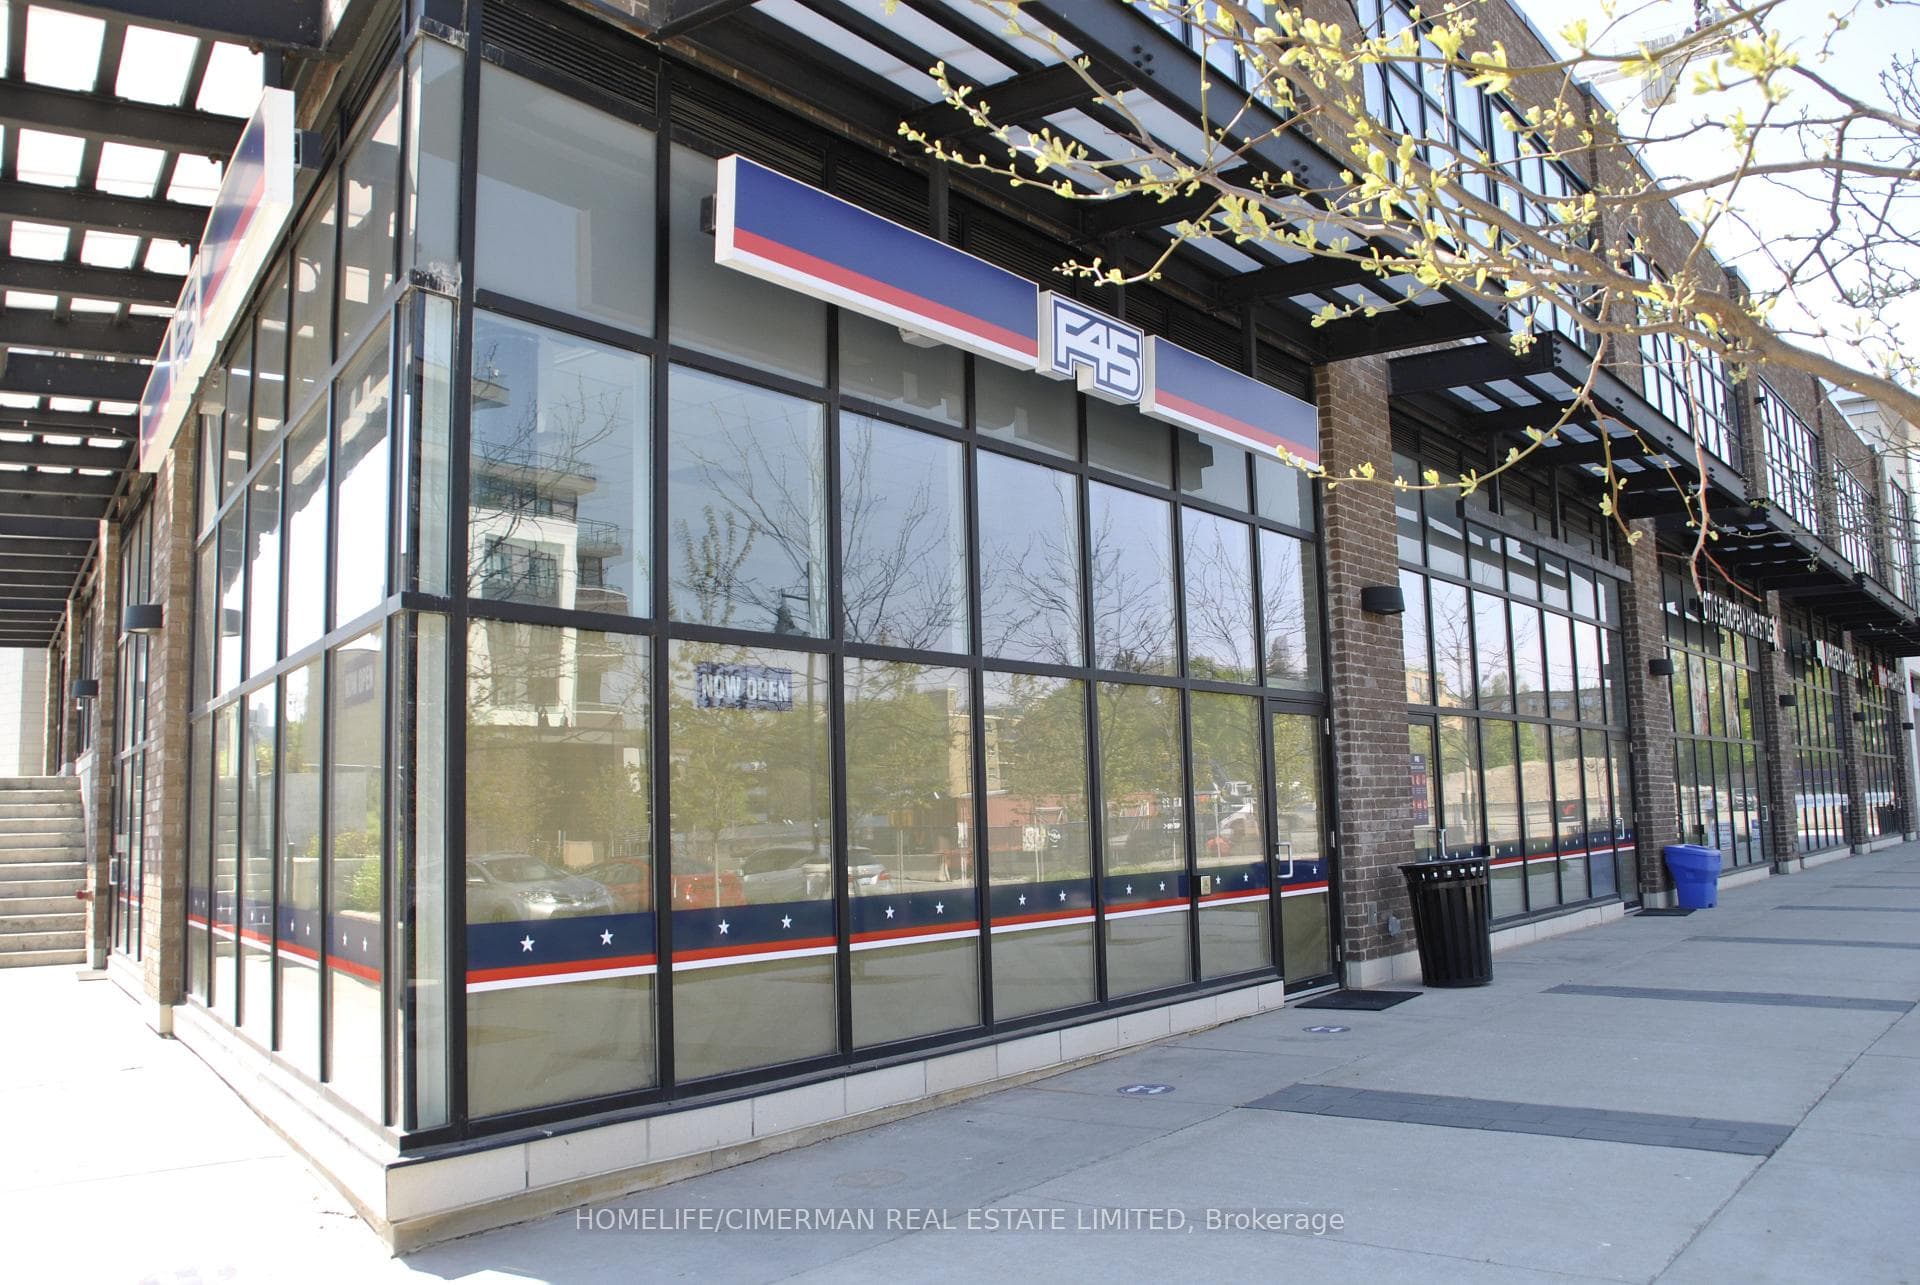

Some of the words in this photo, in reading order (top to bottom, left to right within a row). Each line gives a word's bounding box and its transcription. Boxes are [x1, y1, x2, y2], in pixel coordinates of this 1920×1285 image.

[1053, 298, 1141, 398] F45
[701, 673, 741, 699] NOW
[746, 677, 789, 702] OPEN
